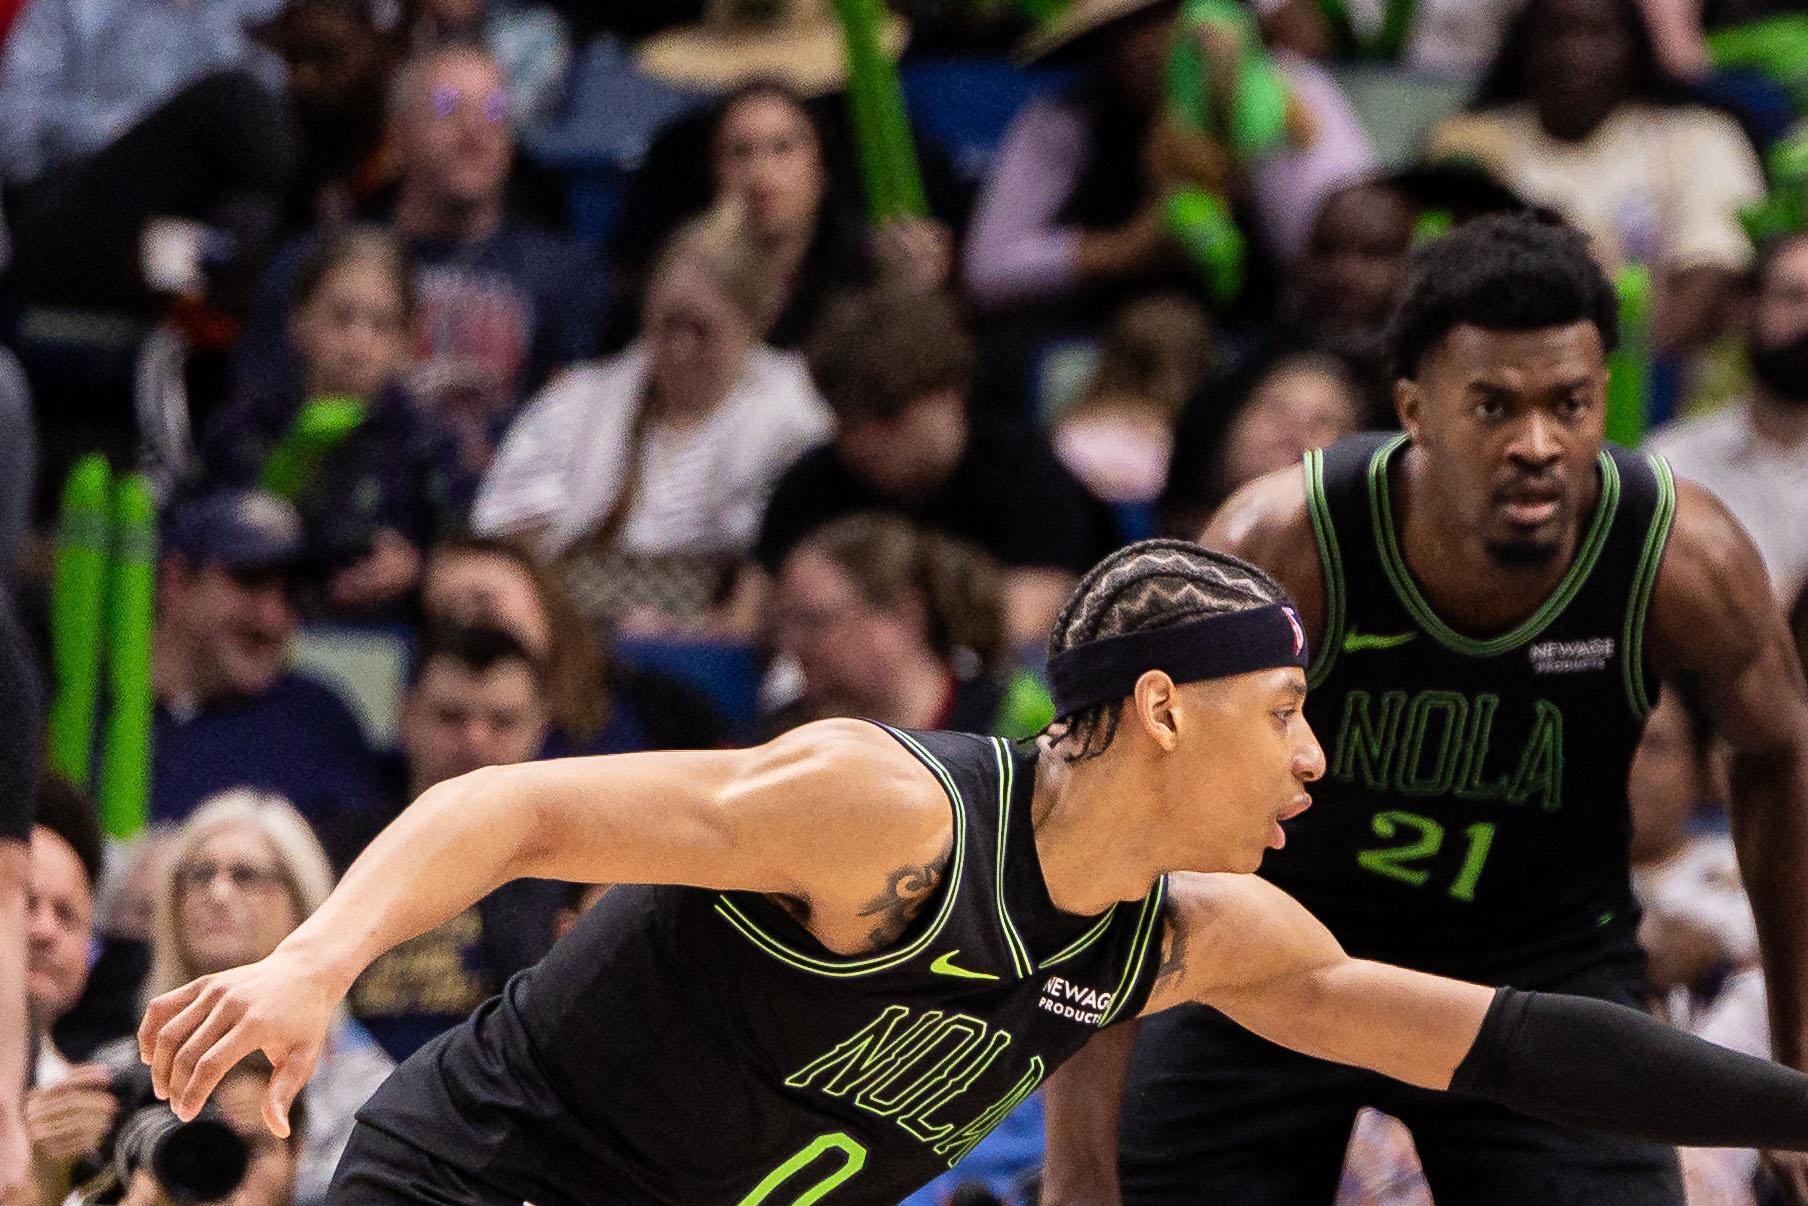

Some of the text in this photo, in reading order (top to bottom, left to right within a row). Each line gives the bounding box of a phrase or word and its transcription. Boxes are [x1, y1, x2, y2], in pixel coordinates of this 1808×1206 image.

[1331, 690, 1565, 810] NOLA
[1357, 810, 1496, 901] 21
[1042, 976, 1116, 1010] NEWAG
[785, 1004, 1045, 1168] NOLA
